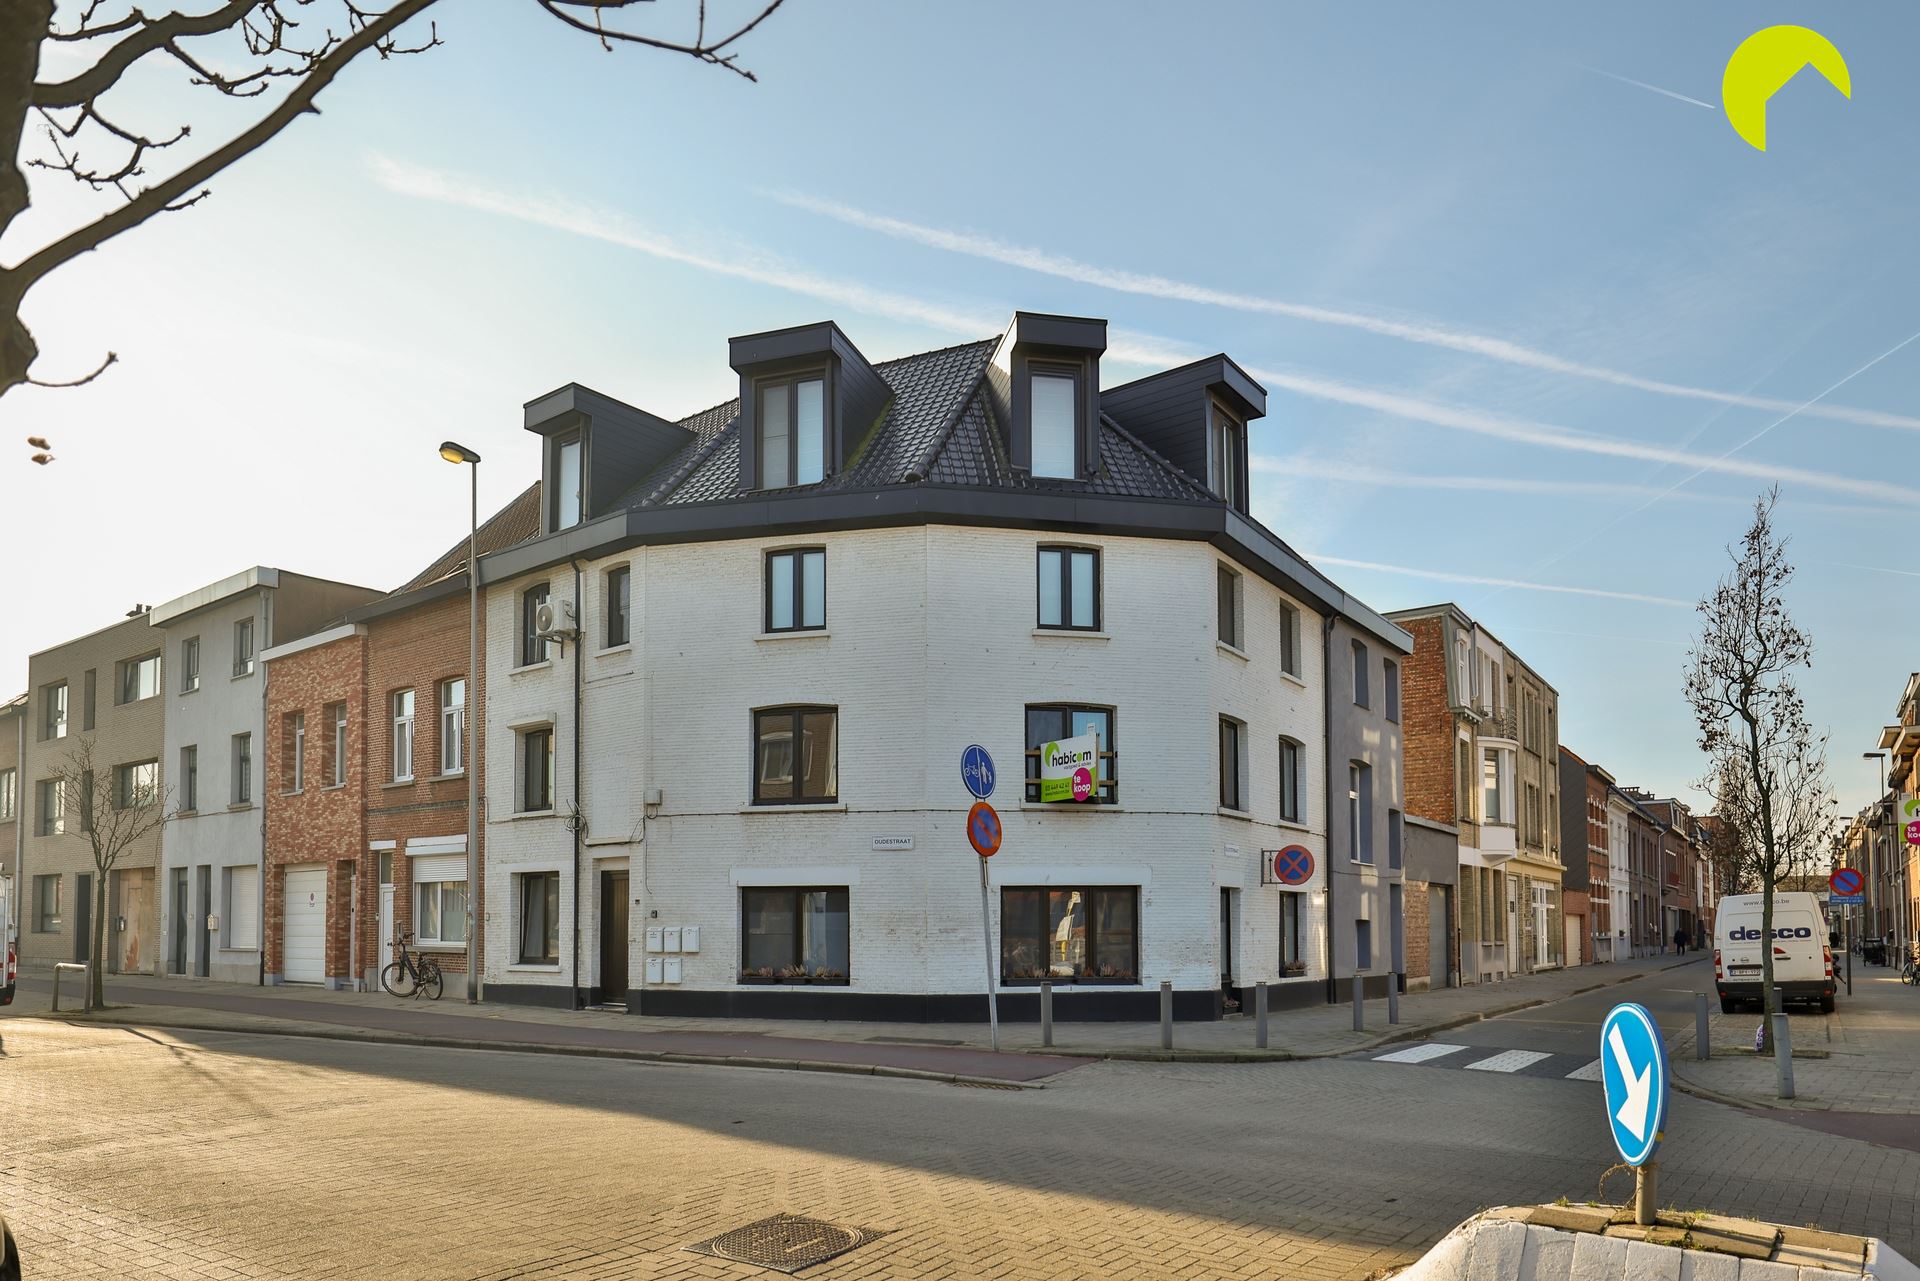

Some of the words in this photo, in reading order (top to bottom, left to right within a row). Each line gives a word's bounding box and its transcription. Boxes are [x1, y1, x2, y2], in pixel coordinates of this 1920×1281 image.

[1052, 751, 1091, 767] habicom
[1073, 775, 1081, 783] te
[1073, 783, 1091, 793] koop
